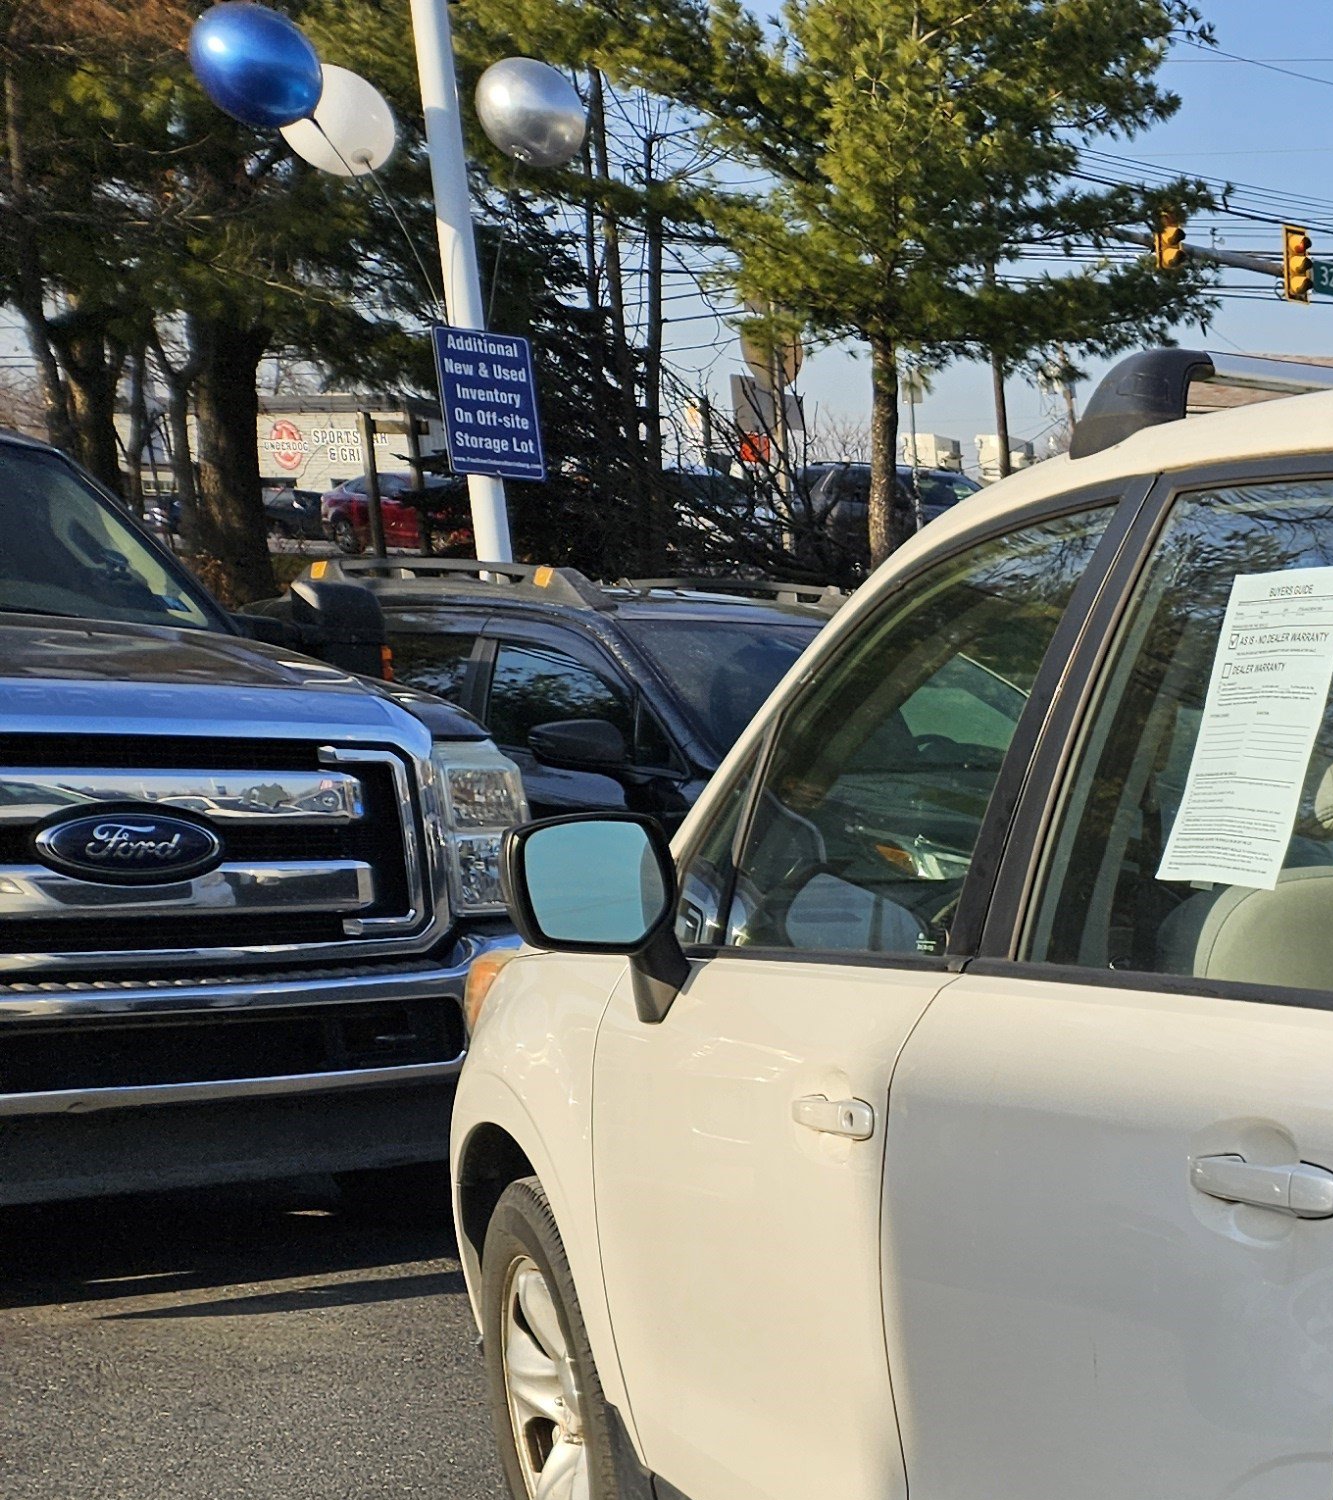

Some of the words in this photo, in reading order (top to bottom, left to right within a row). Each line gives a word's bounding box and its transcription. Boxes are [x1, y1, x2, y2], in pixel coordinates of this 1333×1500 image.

[447, 333, 519, 358] Additional
[444, 358, 474, 376] New
[478, 362, 490, 379] &
[493, 364, 527, 383] Used
[456, 383, 521, 408] Inventory
[454, 408, 473, 424] On
[477, 409, 530, 430] Off-site
[312, 430, 360, 444] SPORTS
[455, 431, 509, 453] Storage
[513, 437, 535, 454] Lot
[264, 441, 309, 452] UNDERDOG
[340, 448, 362, 462] GRI
[1269, 586, 1294, 597] BUYERS
[1294, 584, 1314, 595] GUIDE
[1258, 634, 1267, 644] NO
[1267, 633, 1290, 644] DEALER
[1290, 632, 1329, 642] WARRANTY
[1232, 664, 1254, 675] DEALER
[1254, 662, 1286, 673] WARRANTY
[85, 823, 181, 859] Ford
